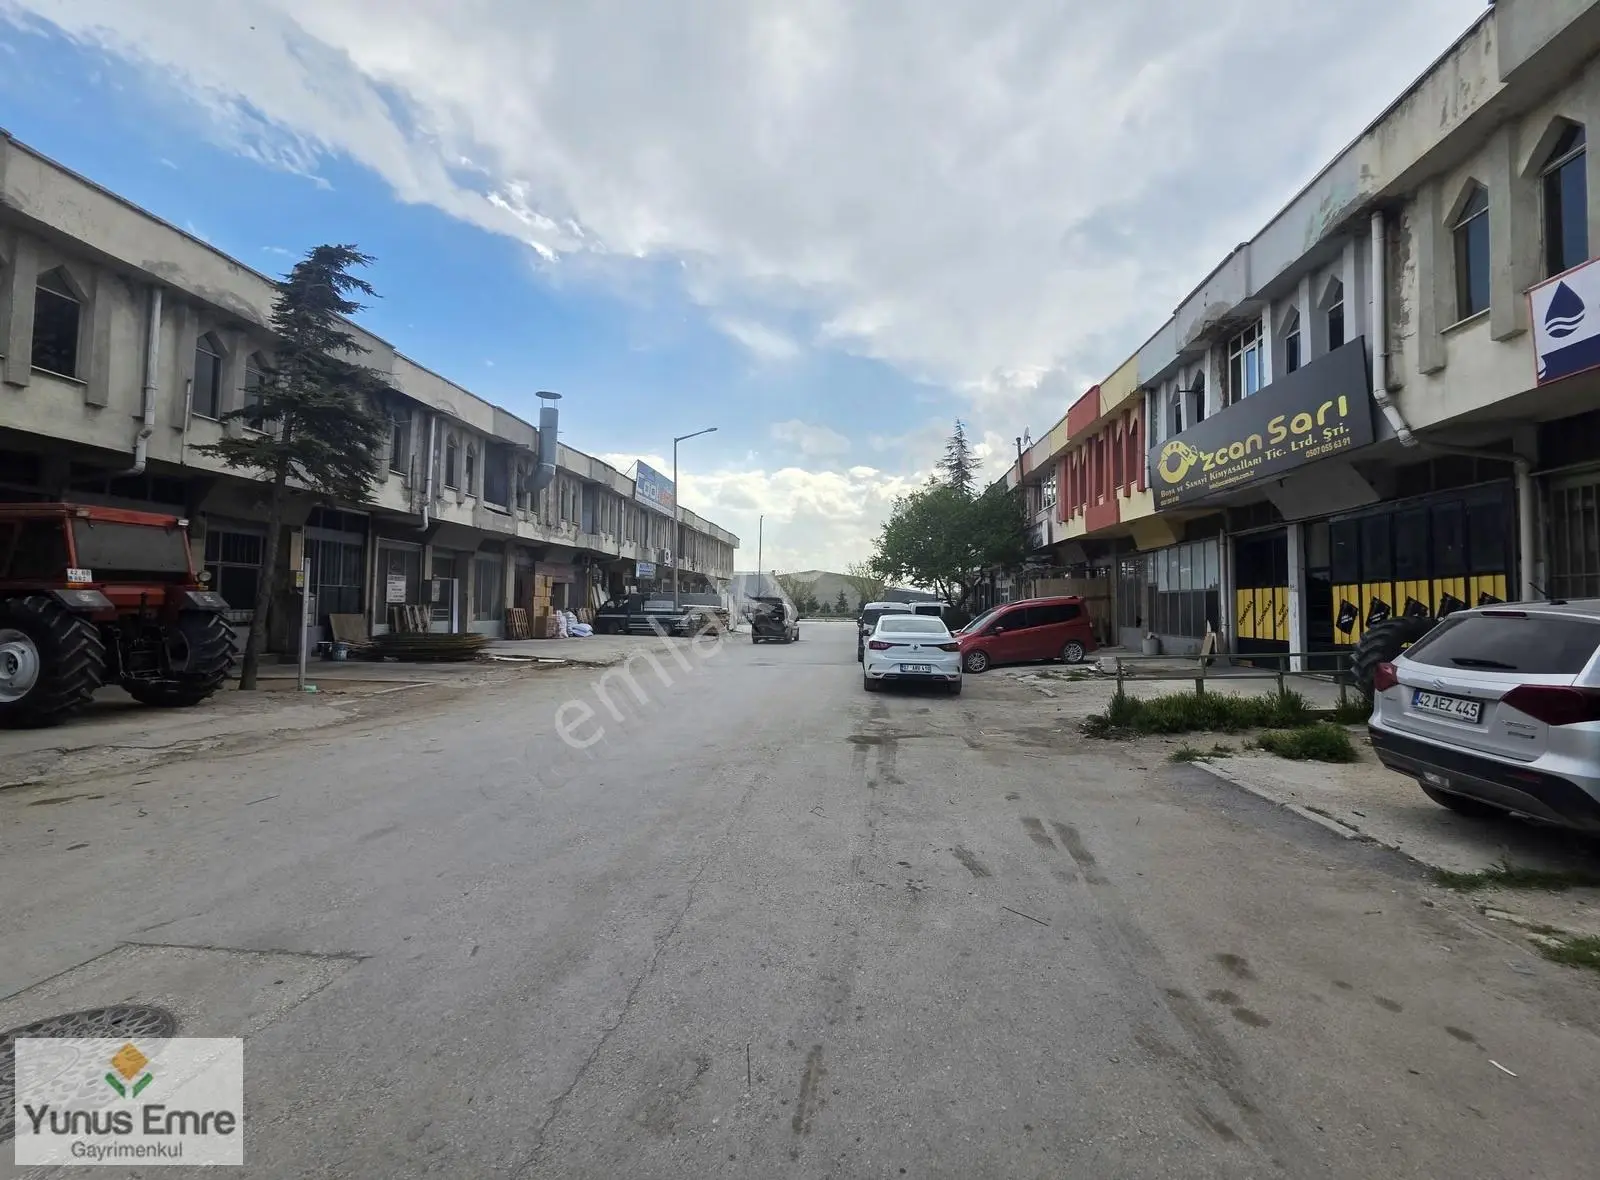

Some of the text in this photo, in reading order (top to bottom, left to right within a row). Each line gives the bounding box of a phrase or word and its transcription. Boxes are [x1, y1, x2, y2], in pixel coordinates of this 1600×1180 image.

[1267, 395, 1348, 445] Sarı
[1265, 447, 1287, 460] Tic.
[1291, 433, 1317, 452] Ltd.
[1418, 692, 1478, 717] 42 AEZ 445
